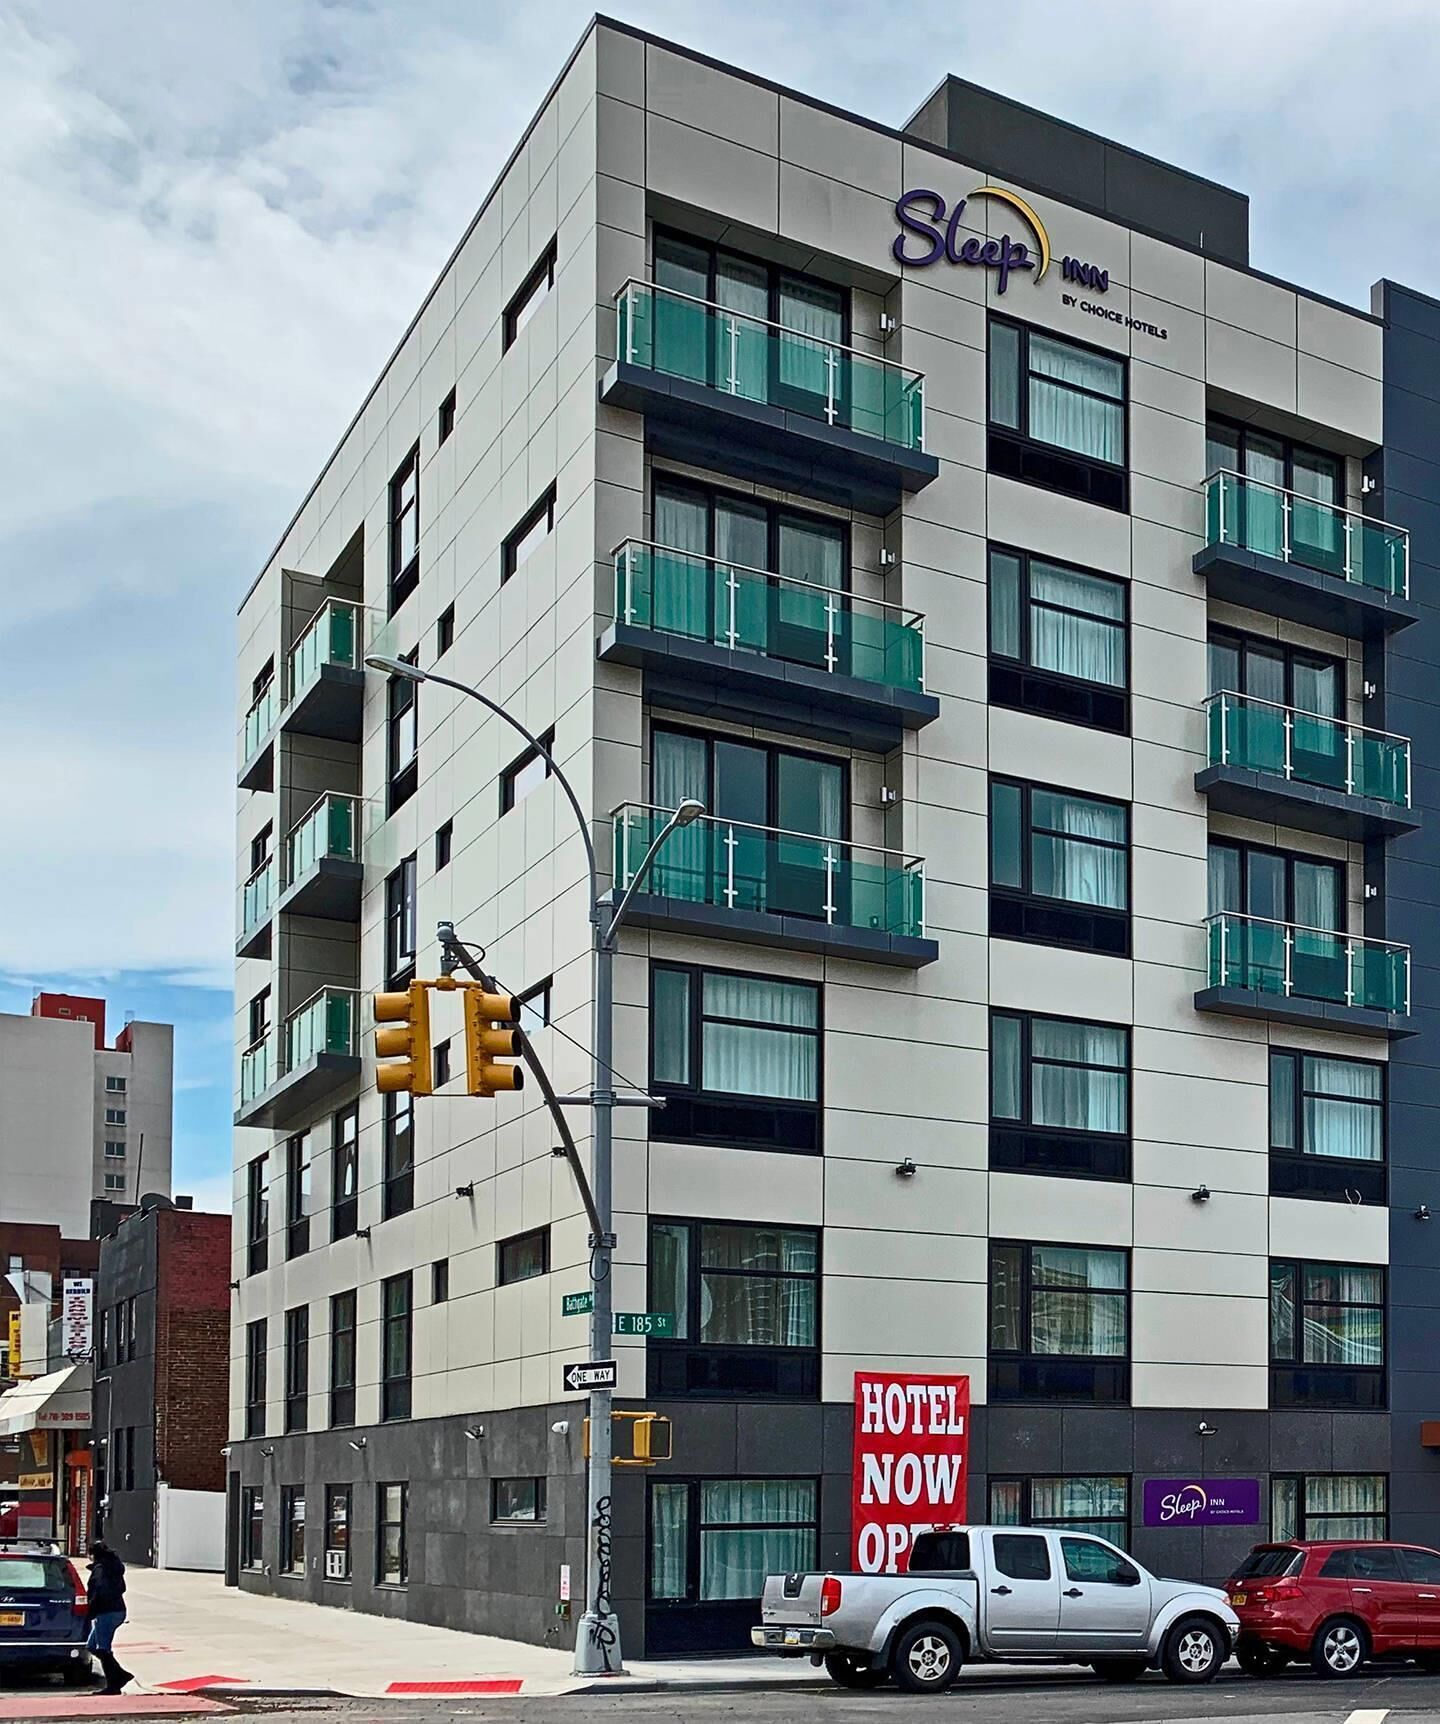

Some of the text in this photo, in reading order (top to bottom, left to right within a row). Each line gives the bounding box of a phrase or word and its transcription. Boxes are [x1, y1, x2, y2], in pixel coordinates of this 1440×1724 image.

[892, 188, 1110, 295] Sleep INN
[1062, 294, 1169, 340] BY CHOICE HOTELS
[566, 1294, 589, 1313] Bathgate
[618, 1315, 666, 1333] E 185 St
[571, 1369, 611, 1383] ONE WAY
[861, 1382, 964, 1435] HOTEL
[860, 1452, 963, 1506] NOW
[1160, 1493, 1202, 1521] Sleep
[858, 1522, 961, 1574] OP
